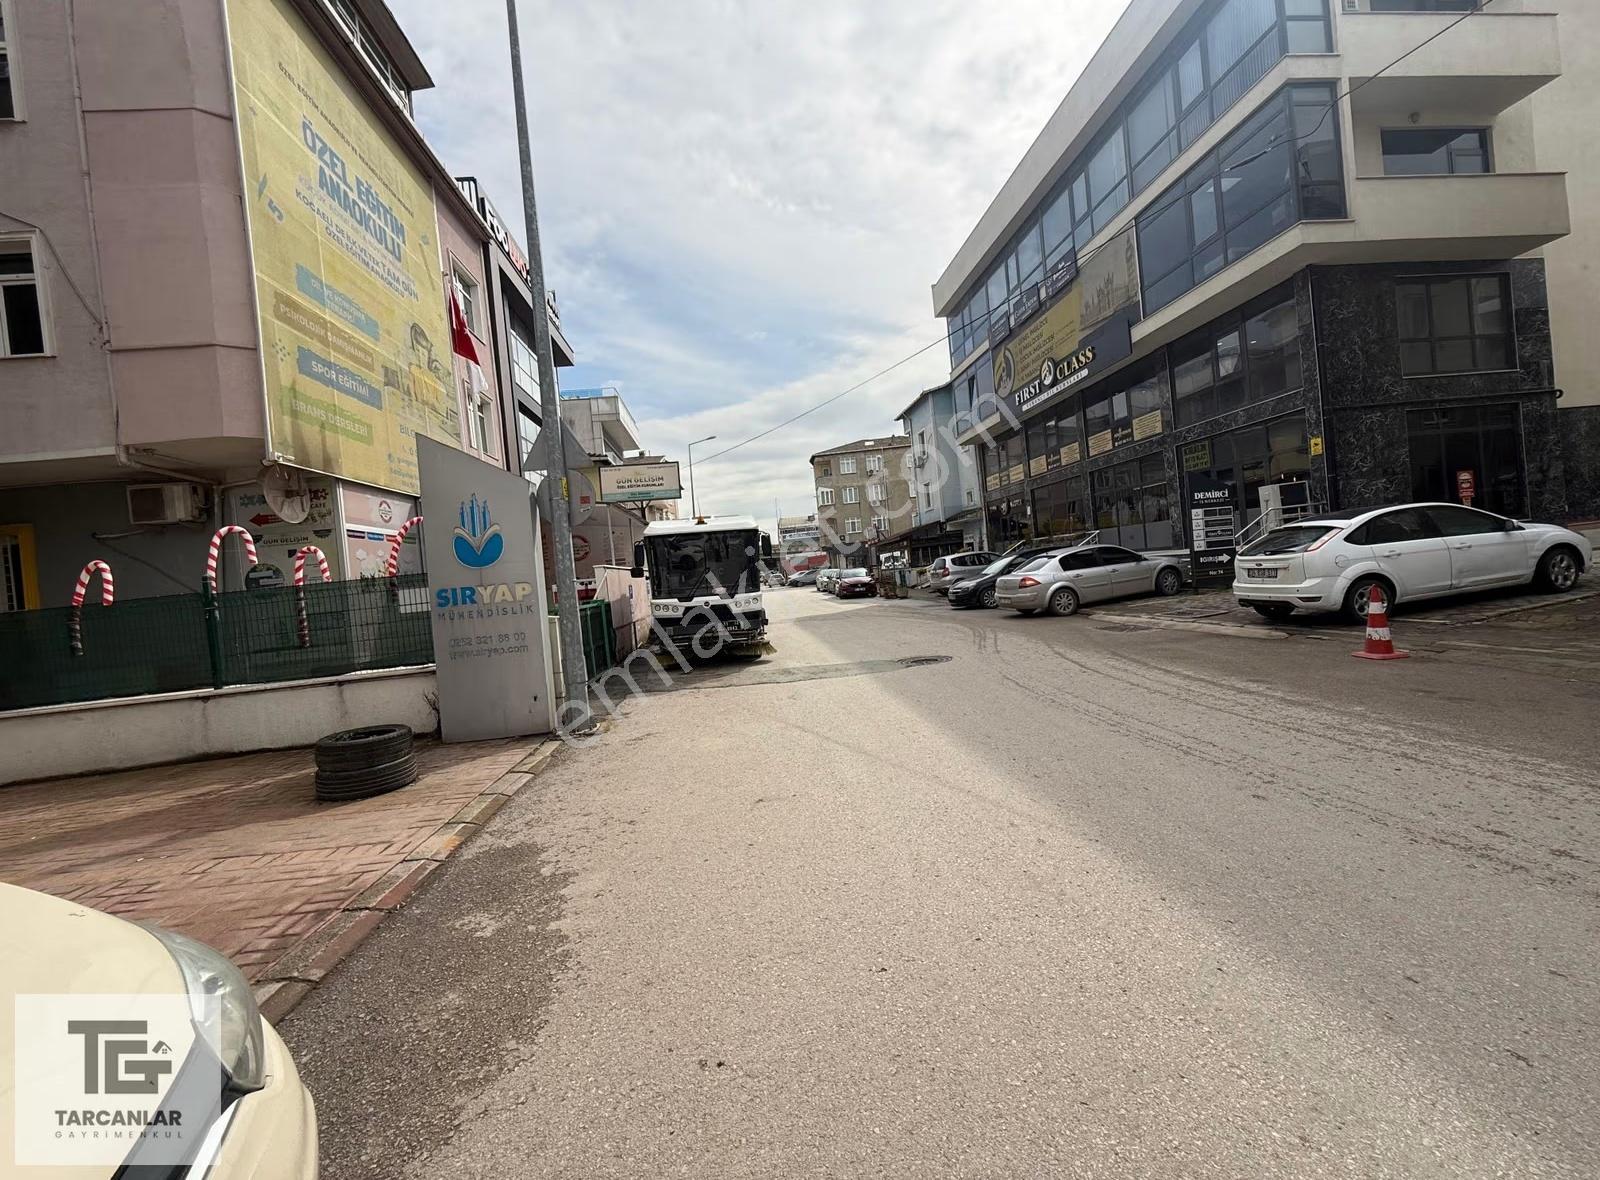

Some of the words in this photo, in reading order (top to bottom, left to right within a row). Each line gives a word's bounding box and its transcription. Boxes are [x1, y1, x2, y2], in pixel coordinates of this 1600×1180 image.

[301, 112, 353, 193] ÖZEL
[355, 174, 406, 246] EĞİTİM
[318, 164, 401, 262] ANAOKULU
[312, 361, 337, 381] SPOR
[1015, 379, 1041, 406] FIRST
[1056, 346, 1094, 380] CLASS
[1195, 488, 1228, 500] DEMİRCİ
[436, 582, 532, 608] SIRYAP
[438, 604, 534, 621] MÜHENDİSLİK
[514, 632, 526, 641] 00
